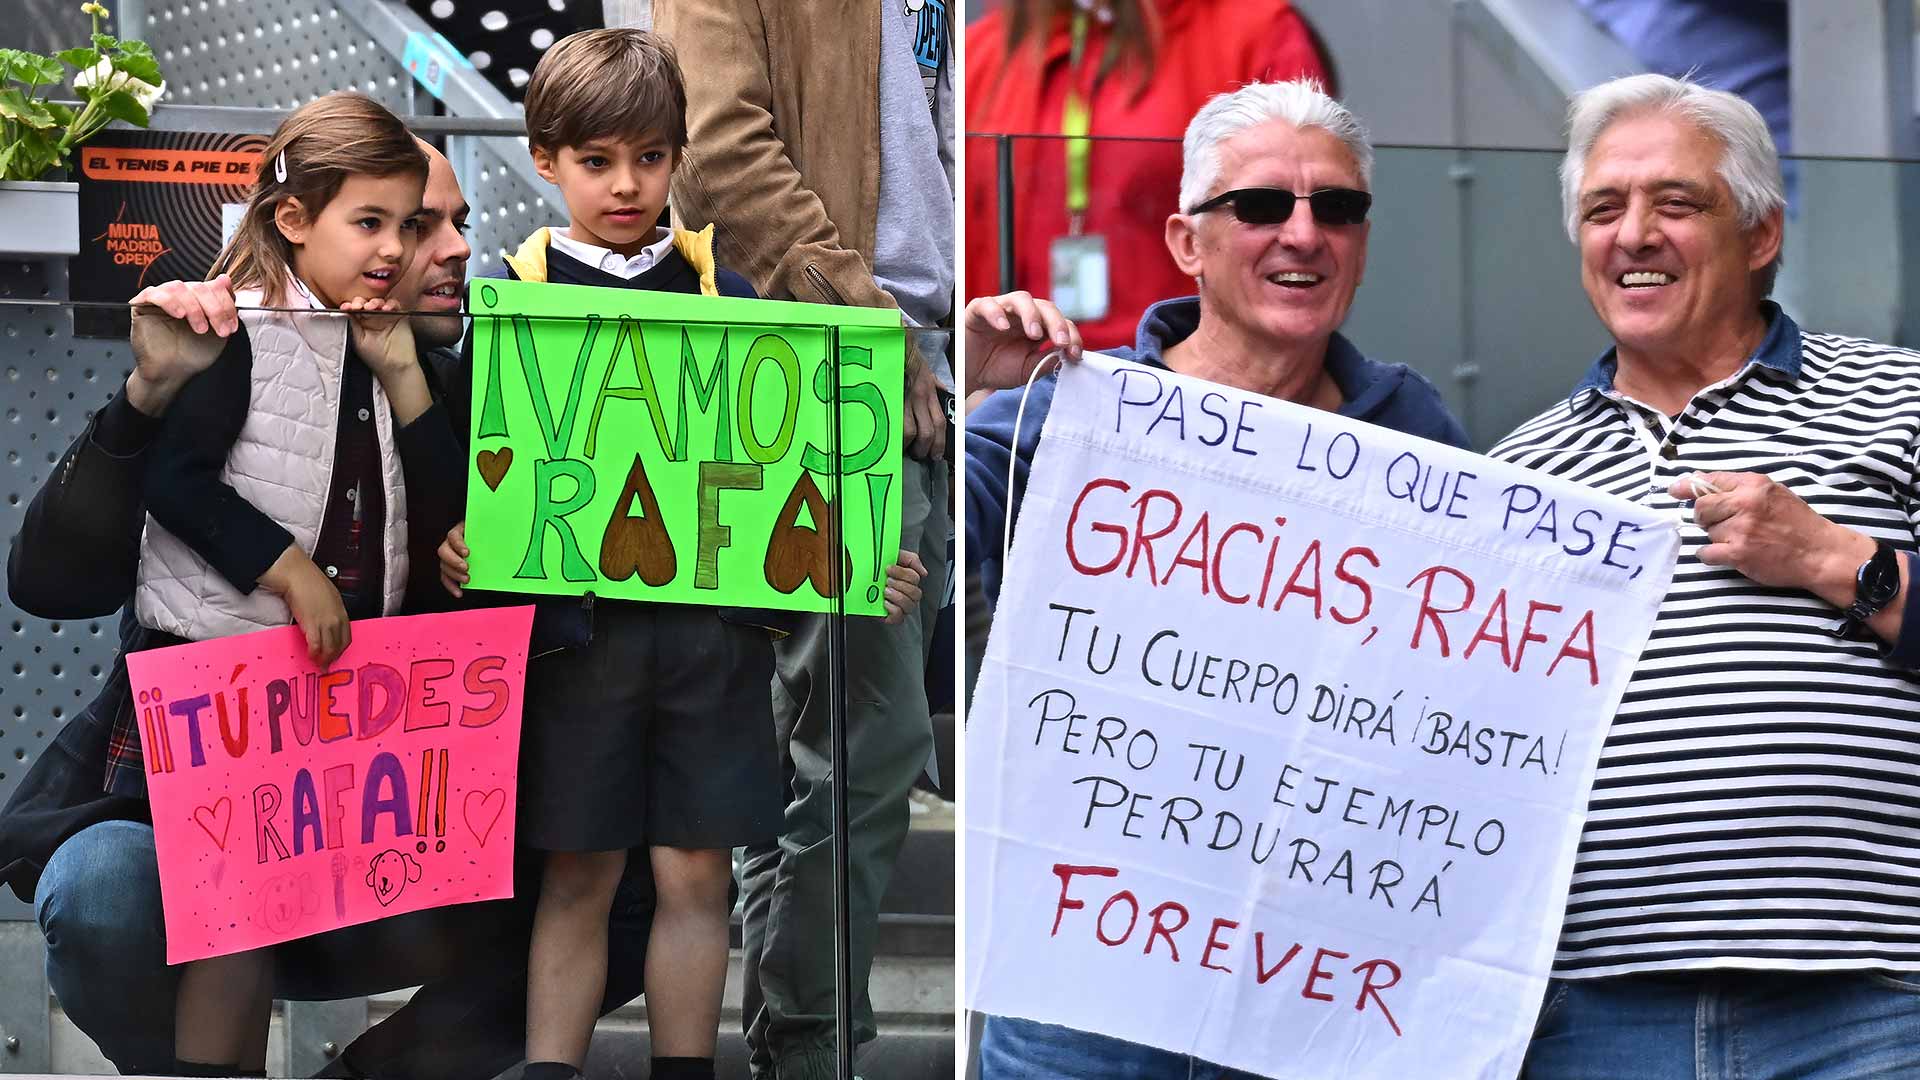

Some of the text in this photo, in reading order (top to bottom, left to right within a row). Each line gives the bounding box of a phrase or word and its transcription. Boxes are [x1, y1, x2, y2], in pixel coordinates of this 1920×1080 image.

[89, 157, 110, 170] EL
[116, 158, 169, 172] TENIS
[173, 160, 186, 172] A
[191, 161, 221, 173] PIE
[226, 162, 250, 174] DE
[106, 240, 163, 251] MADRID
[108, 224, 160, 240] MUTUA
[113, 253, 154, 265] OPEN
[477, 284, 891, 477] ¡VAMOS
[512, 452, 894, 604] RAFA!
[1112, 368, 1644, 581] PASE LO QUE PASE,
[1049, 603, 1121, 675] TU
[1141, 629, 1299, 716] CUERPO
[1411, 696, 1568, 776] ¡BASTA!
[1406, 565, 1599, 686] RAFA
[138, 656, 511, 775] ¡¡TÚ PUEDES
[1028, 689, 1505, 856] PERO TU EJEMPLO
[252, 748, 449, 865] RAFA!!
[1073, 776, 1443, 917] PERDURARÁ
[1051, 863, 1403, 1037] FOREVER
